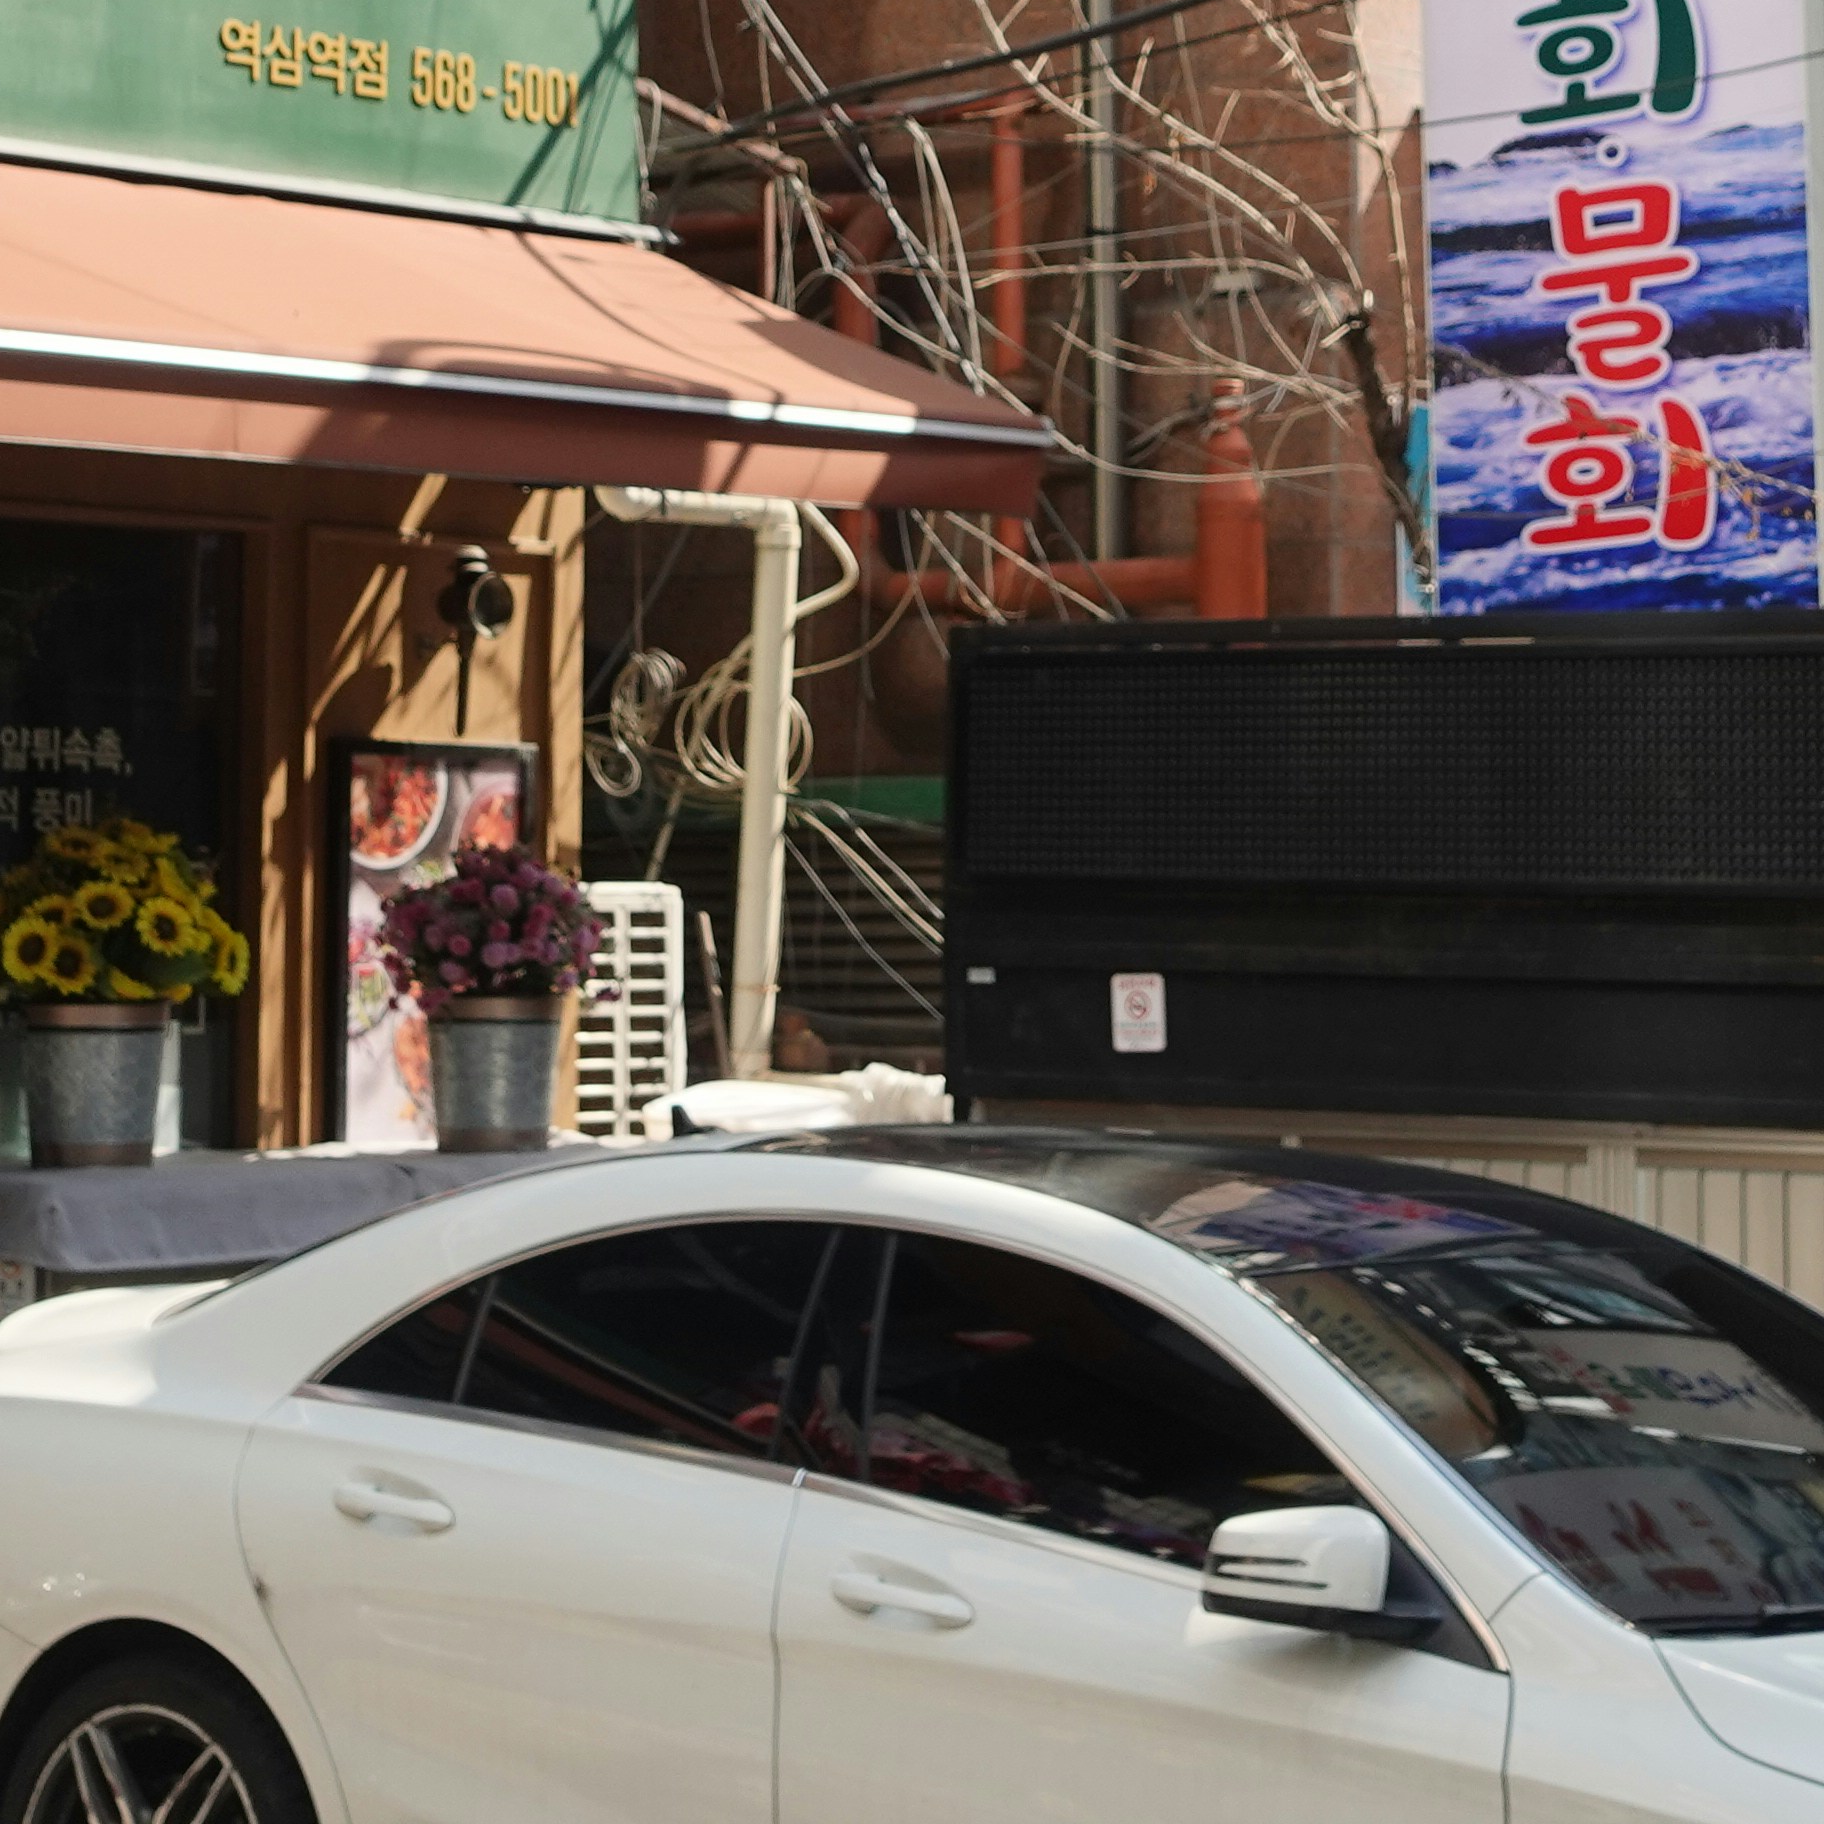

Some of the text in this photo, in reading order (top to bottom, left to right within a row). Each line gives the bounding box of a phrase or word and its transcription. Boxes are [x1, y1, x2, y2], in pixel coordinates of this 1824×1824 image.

[220, 17, 389, 101] 역삼역점
[1524, 181, 1715, 551] 물회
[32, 786, 94, 833] 풍미
